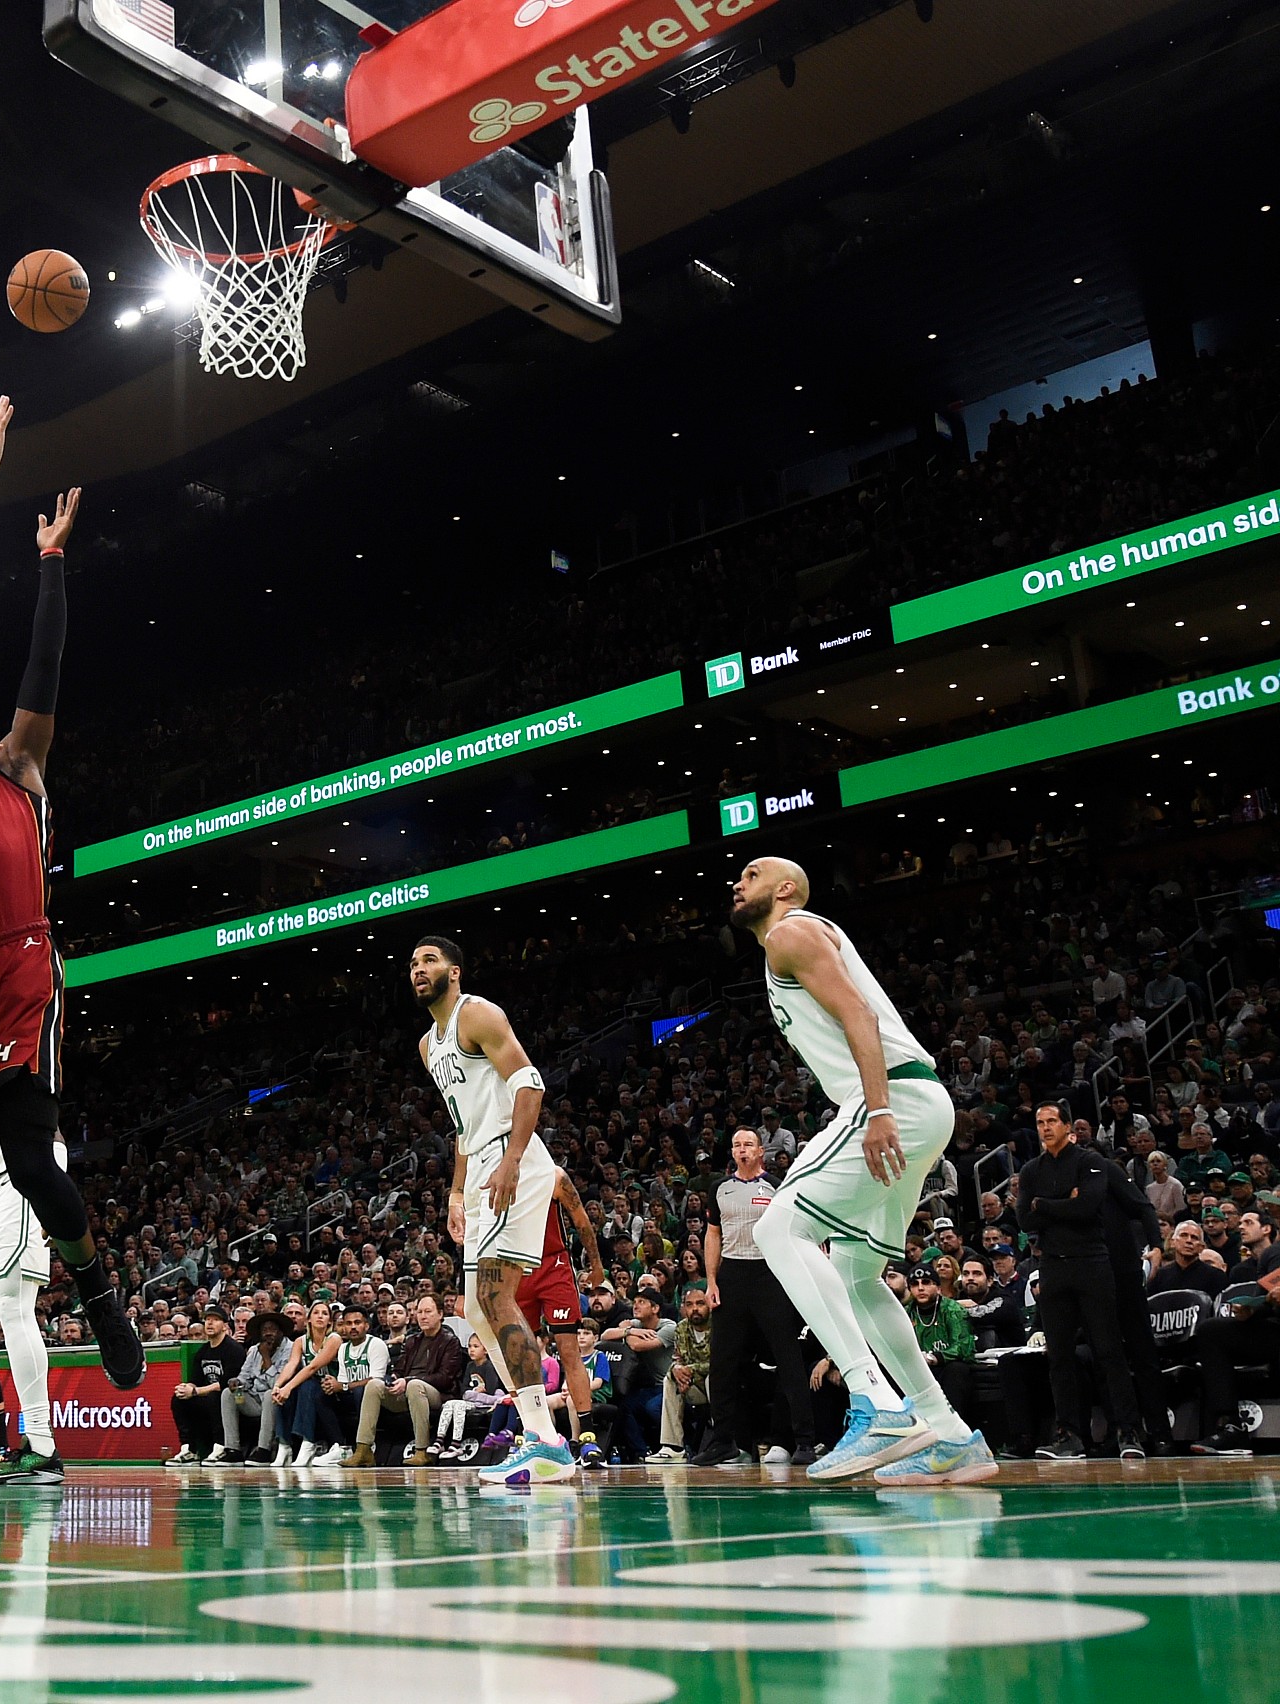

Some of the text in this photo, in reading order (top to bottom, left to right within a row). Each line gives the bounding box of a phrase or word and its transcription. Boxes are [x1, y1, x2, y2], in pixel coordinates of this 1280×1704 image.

[535, 18, 688, 105] State
[1022, 498, 1280, 595] On the human sid
[750, 628, 872, 674] Bank Member FDIC
[709, 661, 740, 687] TD
[1177, 672, 1280, 715] Bank o
[143, 711, 583, 851] On the human side of banking, people matter most.
[723, 800, 755, 828] TD
[765, 788, 814, 815] Bank
[216, 883, 429, 947] Bank of the Boston Celtics
[531, 1073, 541, 1086] 0
[1150, 1305, 1200, 1332] PLAYOFFS
[53, 1398, 152, 1428] Microsoft
